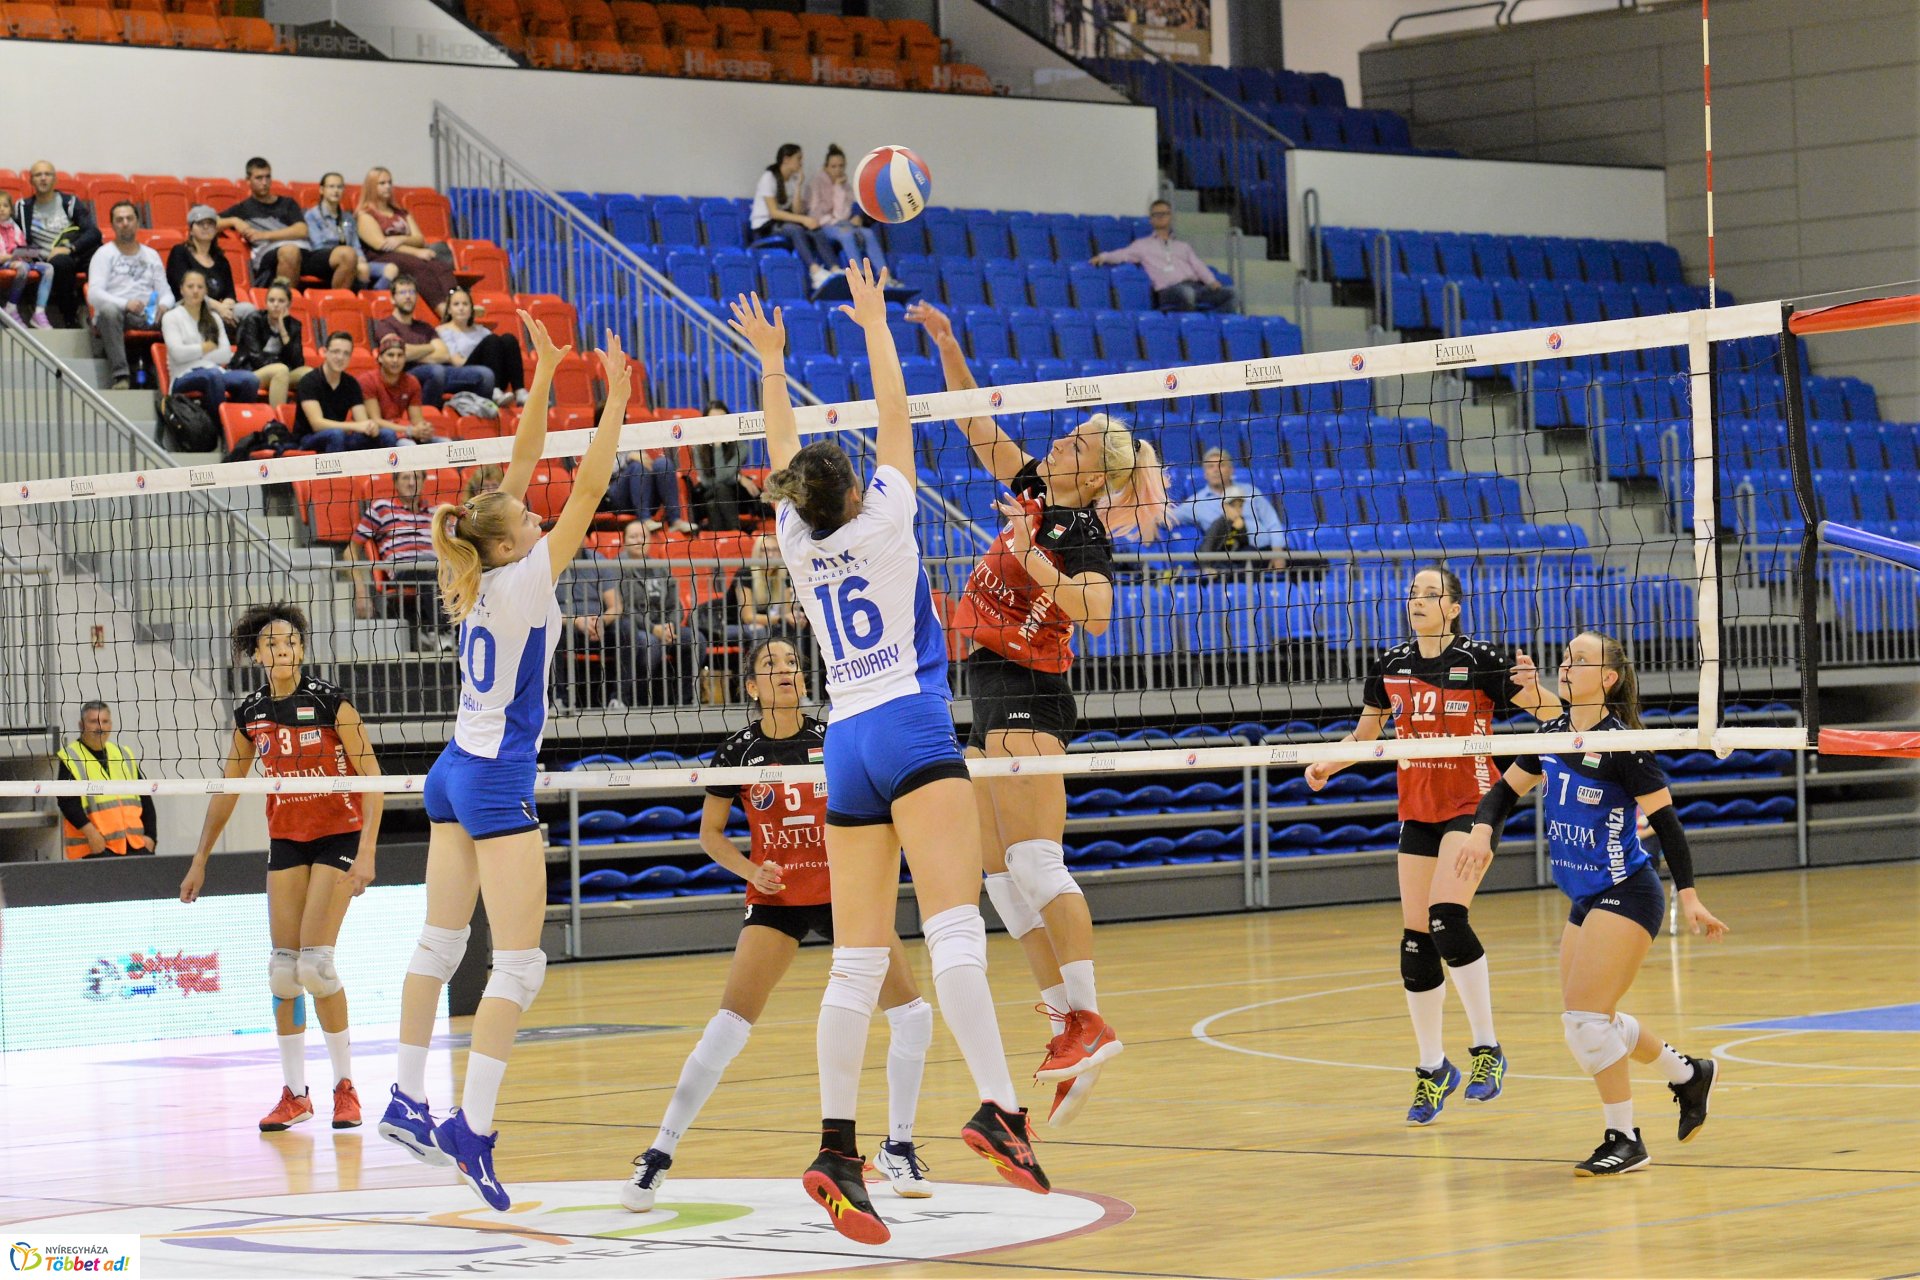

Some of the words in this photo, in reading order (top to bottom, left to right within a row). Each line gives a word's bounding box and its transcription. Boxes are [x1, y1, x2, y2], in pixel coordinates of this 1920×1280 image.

[1435, 343, 1475, 358] FATUM
[1244, 363, 1283, 378] FATUM
[1064, 382, 1102, 396] FATUM
[909, 401, 930, 413] TUM
[447, 445, 477, 458] FATUM
[314, 456, 342, 470] FATUM
[189, 469, 215, 482] FATUM
[70, 479, 95, 491] FATUM
[811, 549, 856, 572] MTK
[808, 559, 869, 582] BUDAPEST
[814, 575, 885, 662] 16
[830, 644, 900, 684] PETOVARY
[1411, 691, 1437, 722] 12
[1445, 701, 1468, 711] FATUM
[1008, 711, 1031, 721] JAKO
[278, 728, 292, 755] 3
[300, 730, 321, 741] FATUM
[1270, 748, 1298, 760] FATUM
[815, 782, 827, 793] FAT
[1558, 771, 1571, 806] 7
[1578, 787, 1602, 799] FATUM
[783, 783, 802, 812] 5
[760, 822, 826, 846] FATU
[1547, 819, 1596, 844] ATUM
[1605, 807, 1629, 886] NYÍREGYHÁZA
[784, 861, 829, 873] NYÍREGYH
[1599, 897, 1621, 907] JAKO
